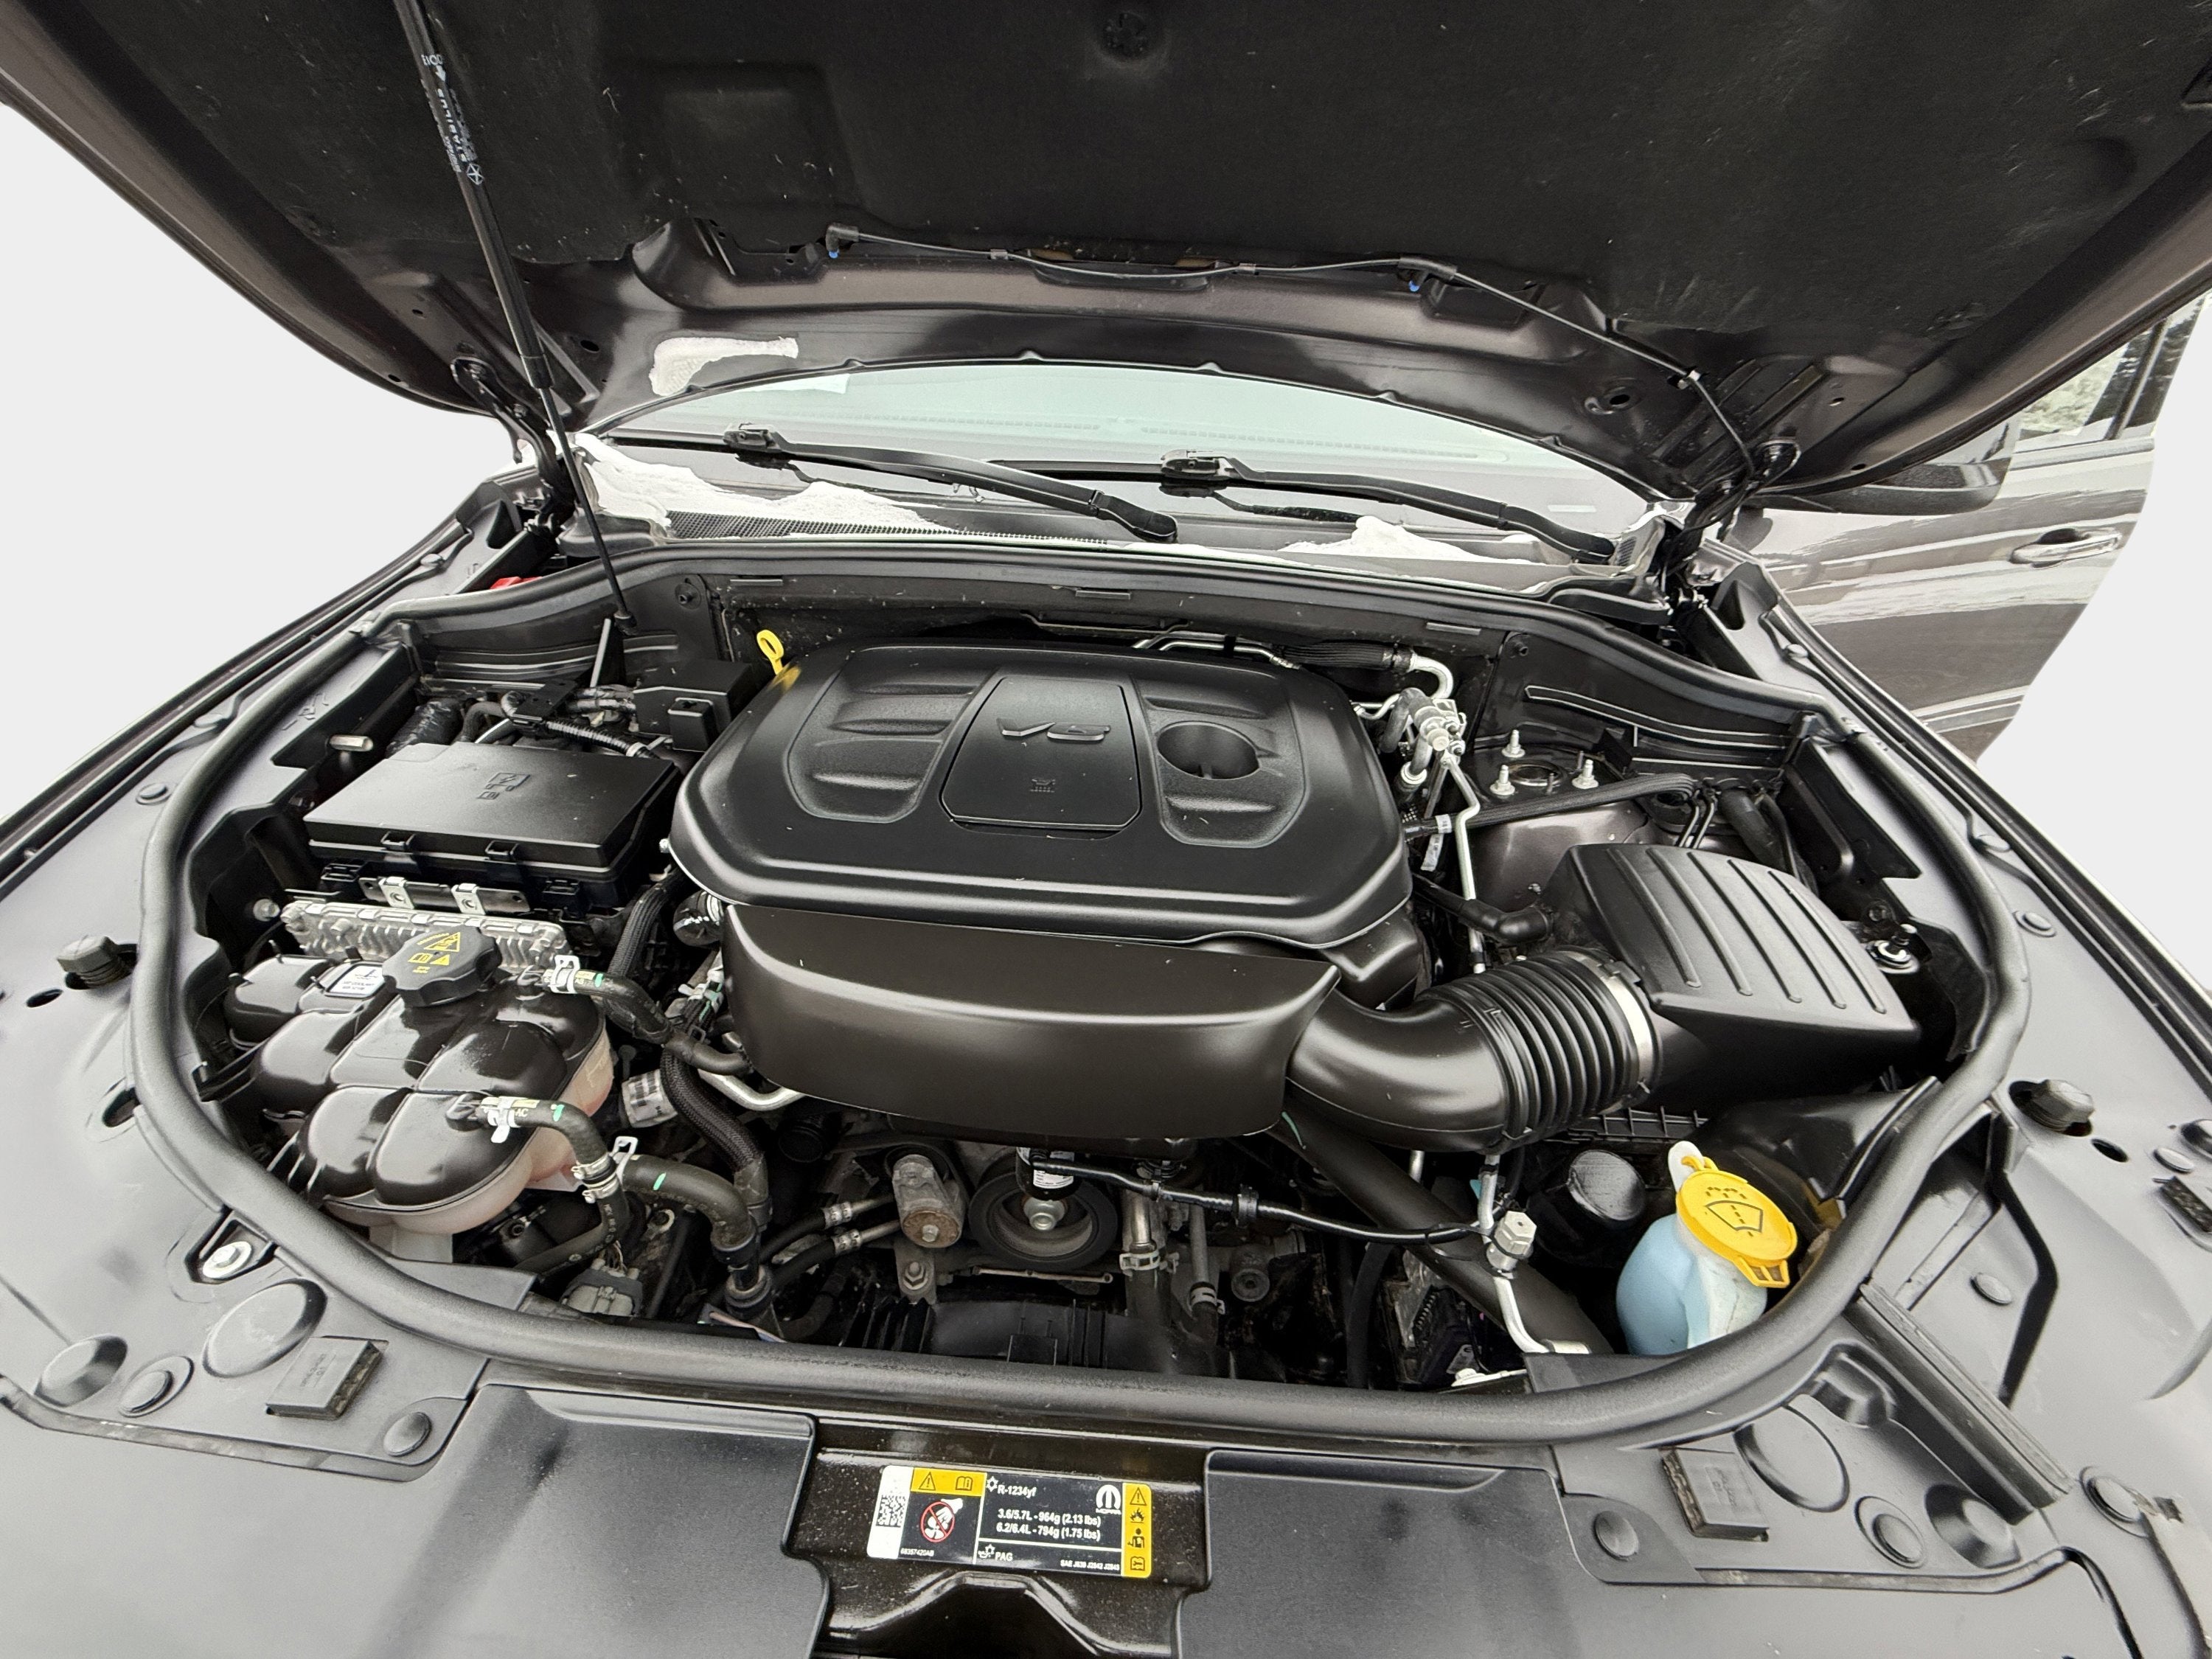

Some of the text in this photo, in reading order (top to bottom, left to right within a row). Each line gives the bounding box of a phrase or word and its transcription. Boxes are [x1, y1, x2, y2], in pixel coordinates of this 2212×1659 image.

[996, 718, 1111, 741] V6
[998, 1484, 1037, 1498] R-1234yf
[998, 1509, 1032, 1520] 3.6/5.7L
[1038, 1512, 1061, 1525] 964g
[1062, 1514, 1083, 1526] (2.13
[1085, 1515, 1101, 1527] lbs)
[996, 1522, 1031, 1534] 6.2/6.4L
[1037, 1525, 1060, 1539] 794g
[1061, 1527, 1082, 1540] (1.75
[1084, 1528, 1101, 1542] lbs)
[995, 1551, 1013, 1562] PAG
